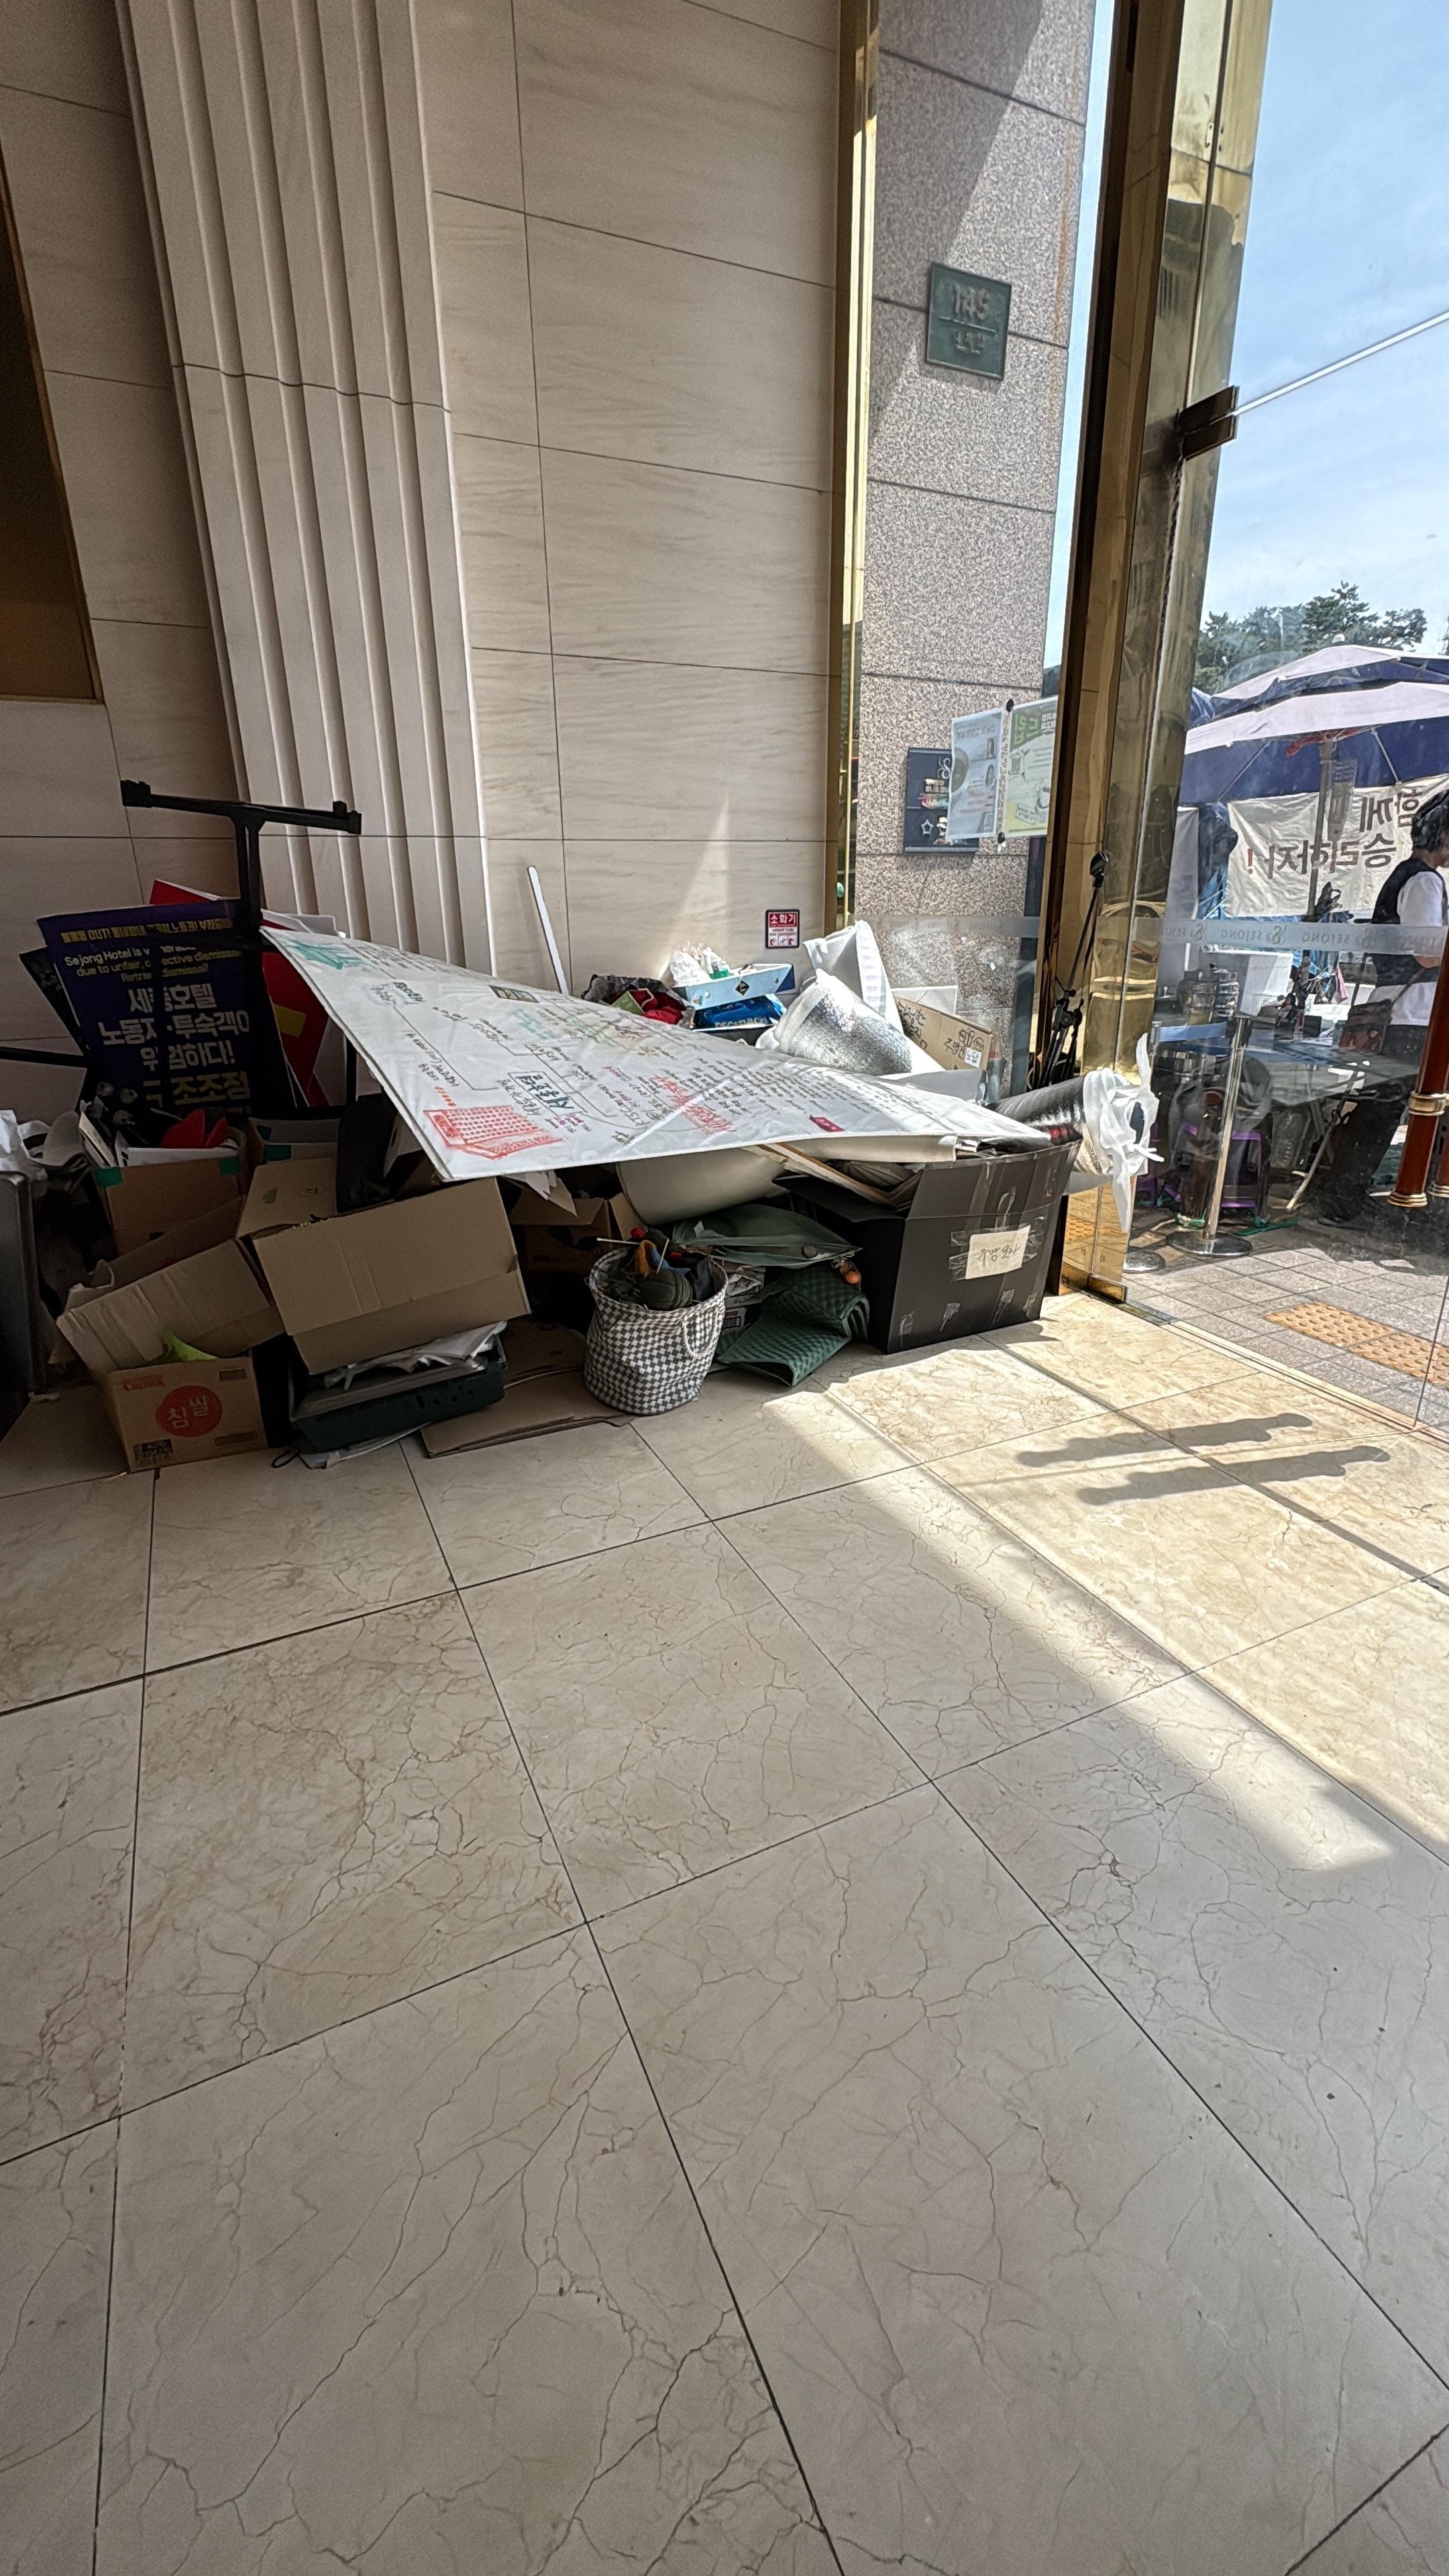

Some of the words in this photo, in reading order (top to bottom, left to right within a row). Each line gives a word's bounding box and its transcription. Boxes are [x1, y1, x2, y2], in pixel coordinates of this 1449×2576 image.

[770, 914, 796, 924] 소화기
[64, 951, 107, 967] Sejong
[105, 947, 131, 961] Hotel
[76, 965, 97, 977] due
[98, 963, 110, 974] to
[166, 1395, 210, 1429] 참쌀
